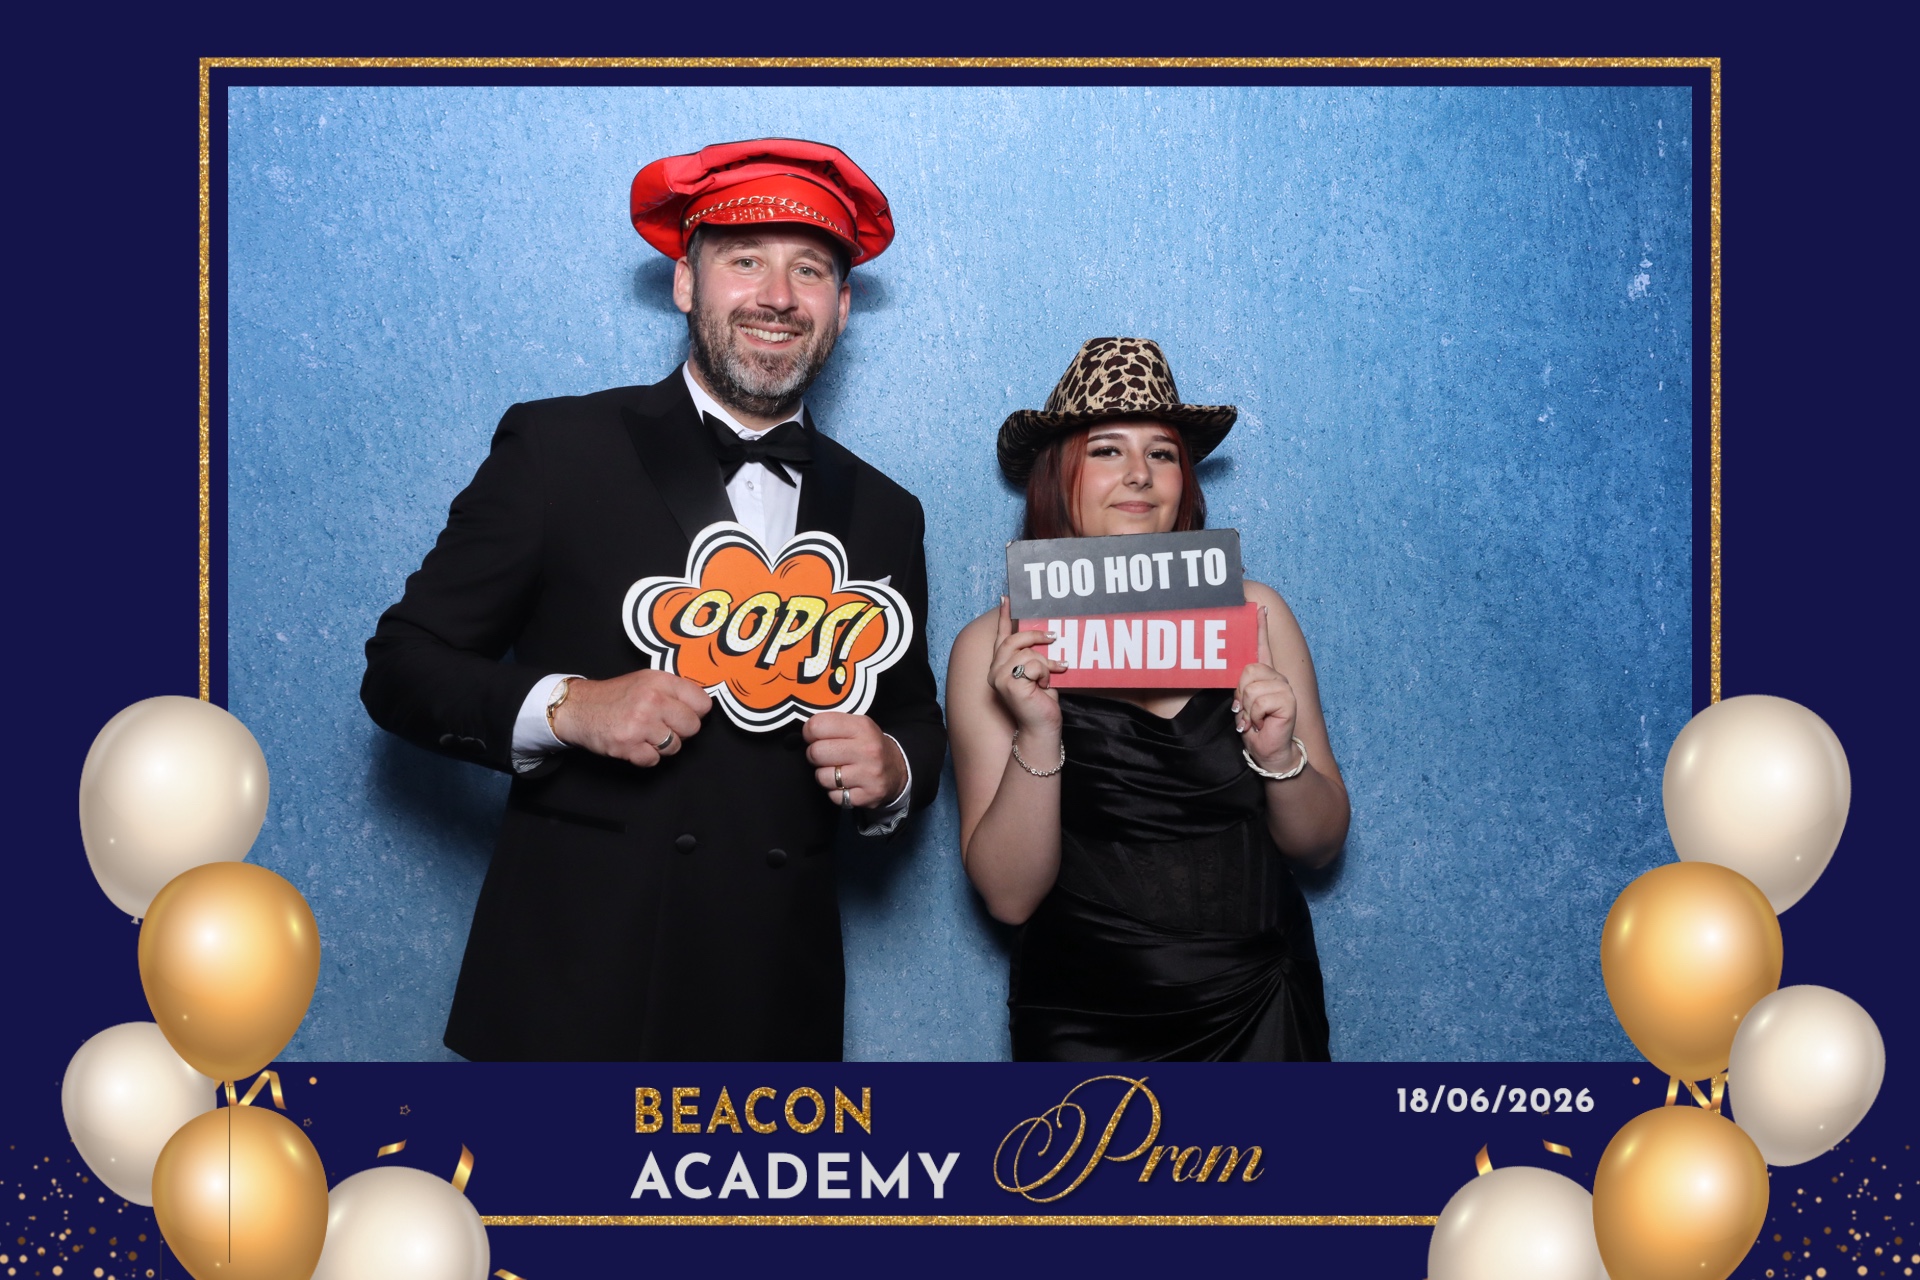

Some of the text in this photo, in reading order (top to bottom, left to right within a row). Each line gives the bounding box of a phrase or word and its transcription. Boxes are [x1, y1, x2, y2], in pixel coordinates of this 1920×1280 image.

[1023, 547, 1228, 600] TOO HOT TO
[669, 589, 889, 695] OOPS!
[1047, 619, 1227, 670] HANDLE
